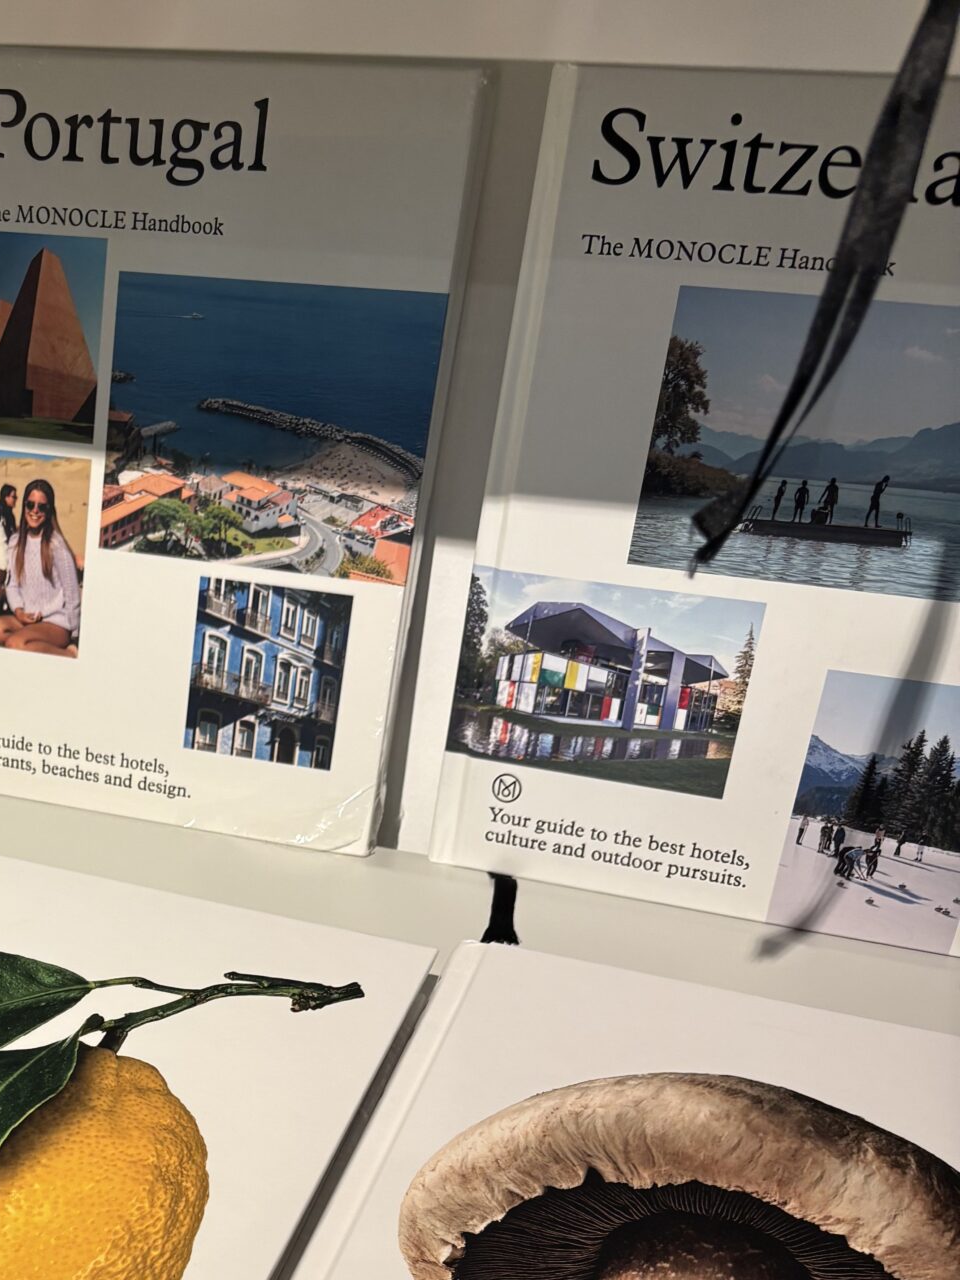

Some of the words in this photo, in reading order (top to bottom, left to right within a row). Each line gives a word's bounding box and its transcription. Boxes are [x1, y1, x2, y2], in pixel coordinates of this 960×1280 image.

[591, 107, 960, 207] Switzea
[15, 204, 126, 229] MONOCLE
[131, 212, 224, 236] Handbook
[581, 234, 624, 257] The
[630, 237, 771, 267] MONOCLE
[38, 741, 53, 756] to
[57, 743, 81, 761] the
[85, 748, 116, 767] best
[120, 752, 170, 777] hotels,
[41, 760, 100, 783] beaches
[104, 770, 133, 789] and
[137, 777, 191, 800] design.
[484, 827, 548, 852] culture
[552, 839, 586, 859] and
[591, 848, 662, 873] outdoor
[665, 862, 747, 889] pursuits.
[488, 806, 531, 829] Your
[534, 816, 585, 839] guide
[590, 825, 608, 842] to
[612, 828, 643, 848] the
[648, 834, 686, 856] best
[690, 842, 751, 871] hotels,
